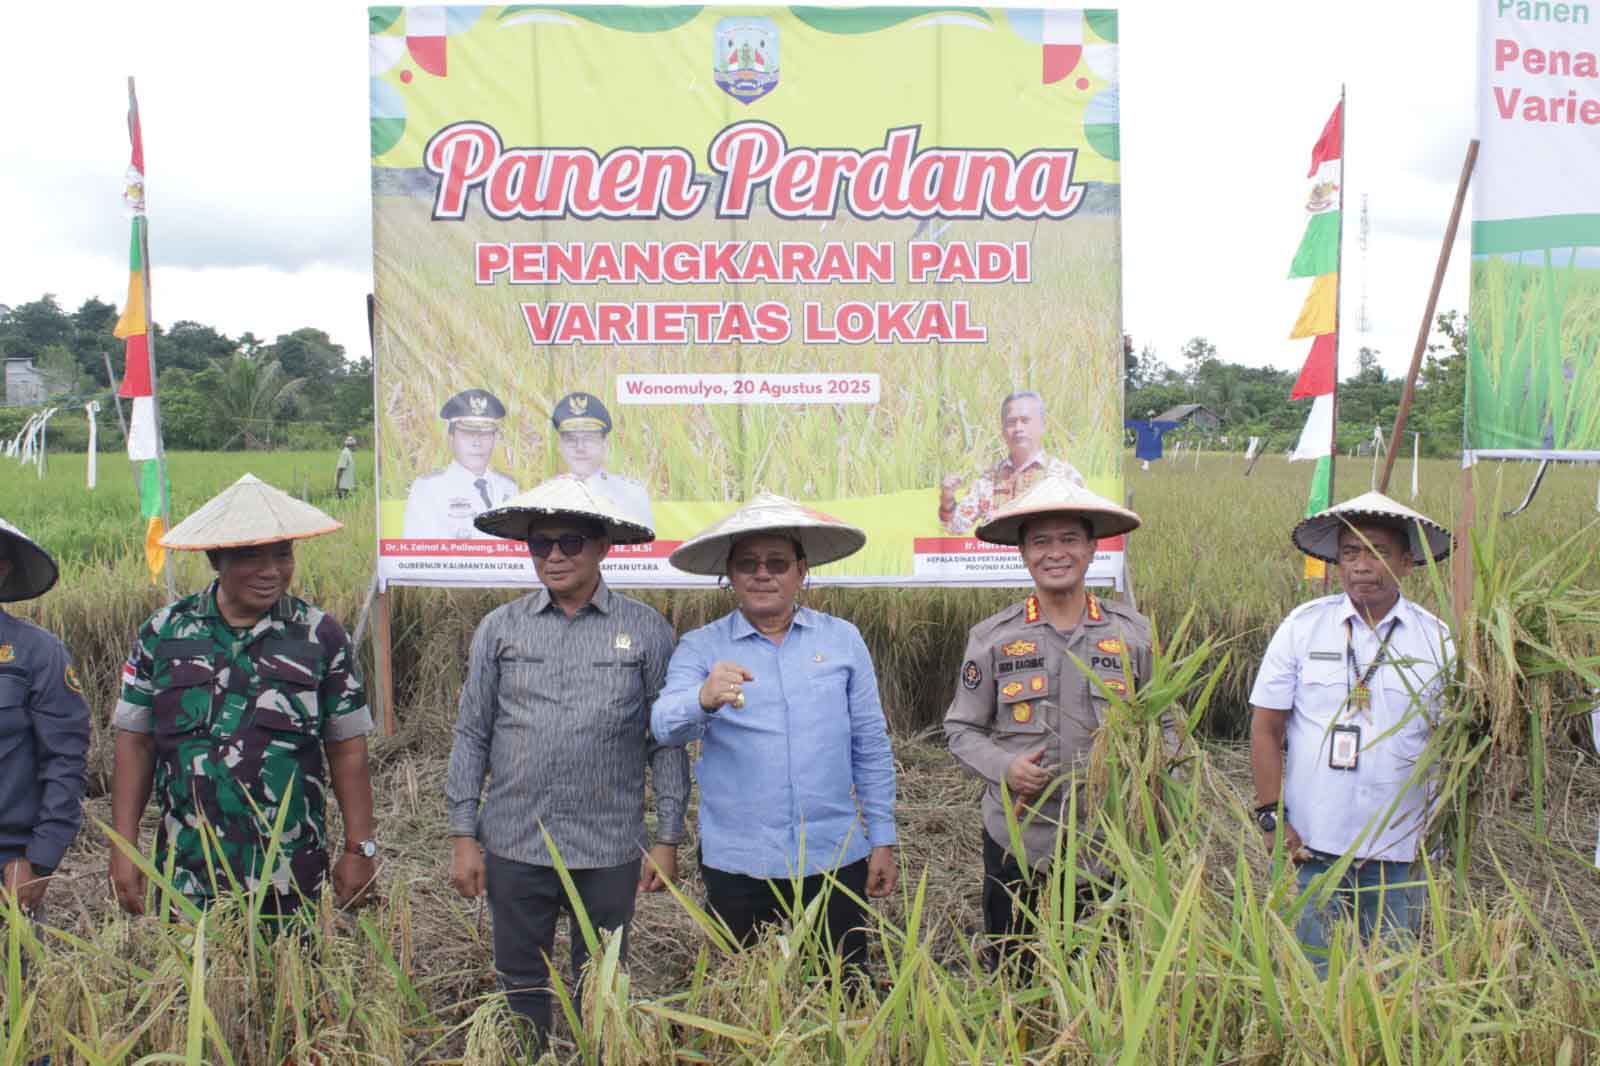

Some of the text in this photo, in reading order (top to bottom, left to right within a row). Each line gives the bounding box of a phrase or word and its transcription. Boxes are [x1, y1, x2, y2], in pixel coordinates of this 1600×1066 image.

[1497, 0, 1589, 24] Panen
[1495, 38, 1600, 79] Pena
[1493, 86, 1600, 125] Varie
[423, 120, 1088, 221] Panen Perdana
[475, 241, 1032, 285] PENANGKARAN PADI
[520, 301, 988, 345] VARIETAS LOKAL
[626, 380, 871, 398] Wonomulyo, 20 Agustus 2025
[385, 543, 399, 551] Dr.
[398, 562, 525, 571] GUBERNUR KALIMANTAN UTARA
[631, 563, 660, 572] UTARA
